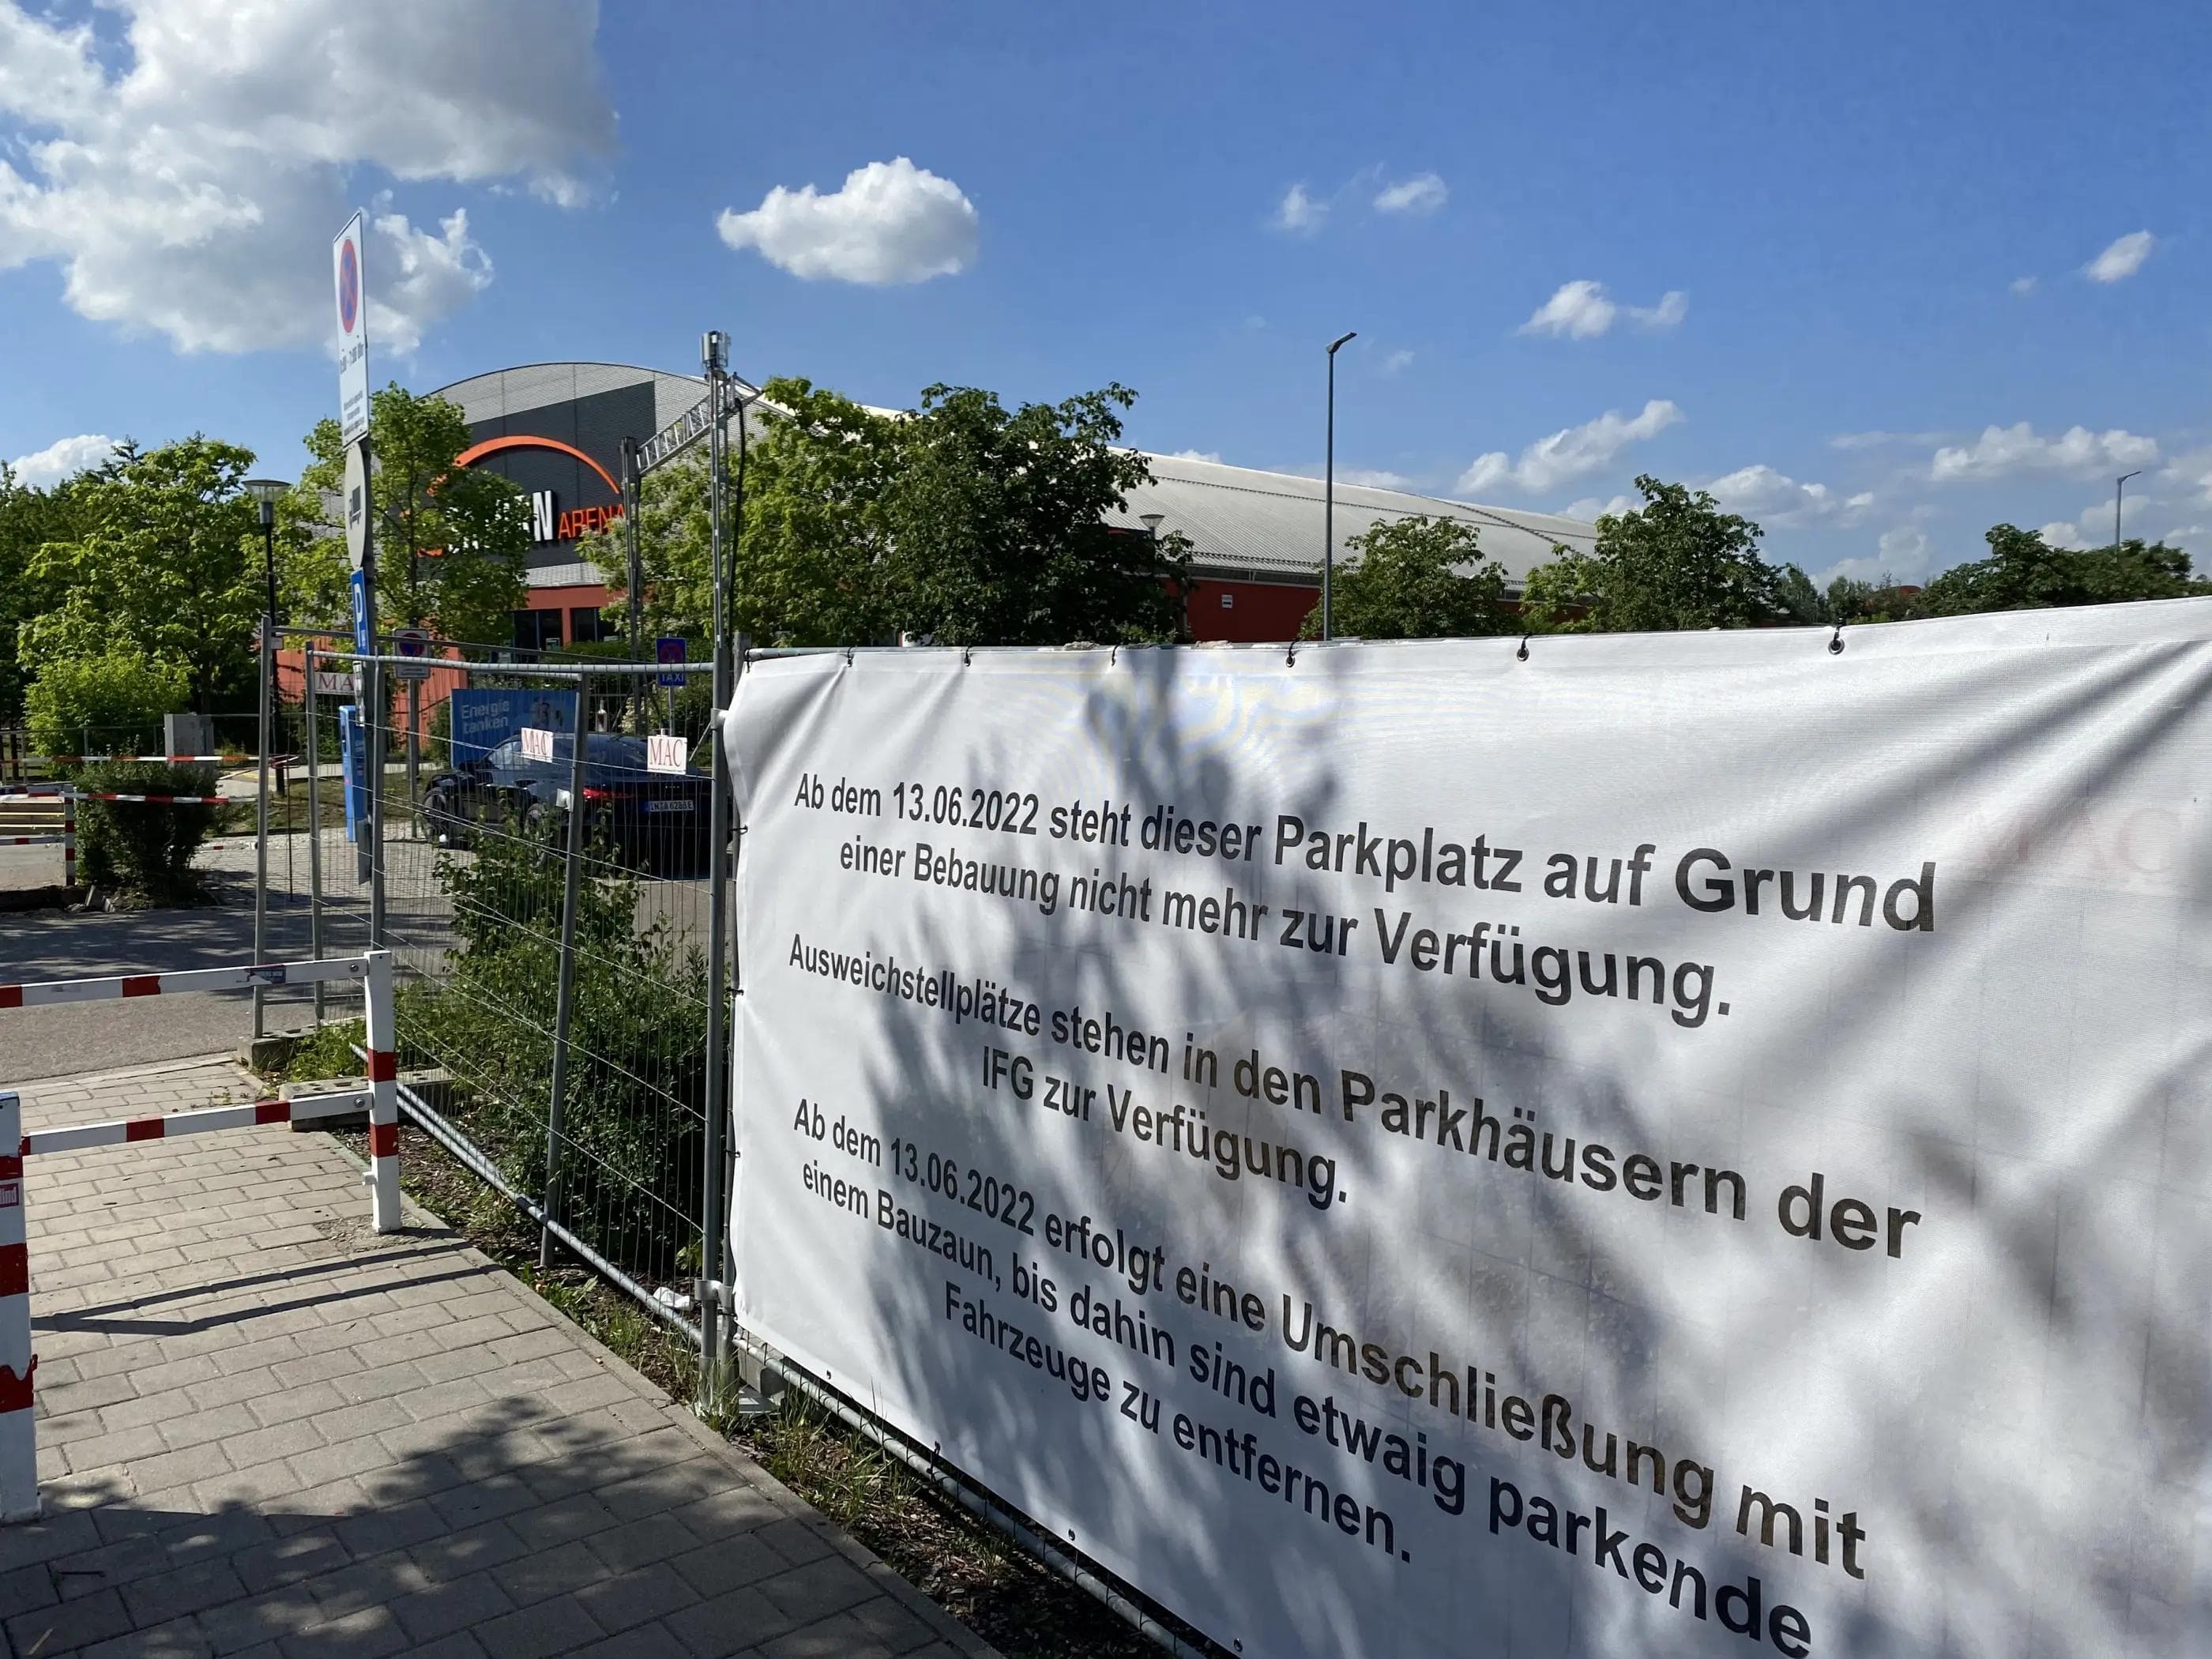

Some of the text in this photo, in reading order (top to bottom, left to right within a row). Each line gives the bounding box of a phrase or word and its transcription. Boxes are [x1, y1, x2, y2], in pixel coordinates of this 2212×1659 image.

[558, 503, 625, 539] ARENA
[318, 673, 355, 691] MA
[461, 699, 510, 720] Energie
[463, 716, 508, 734] tanken
[661, 672, 683, 683] TAXI
[524, 729, 549, 756] MAC
[649, 738, 683, 767] MAC
[795, 773, 1936, 931] Ab dem 13.06.2022 steht dieser Parkplatz auf Grund
[841, 835, 1729, 1028] einer Bebauung nicht mehr zur Verfügung.
[790, 934, 1921, 1258] Ausweichstellplätze stehen in den Parkhäusern der
[984, 1046, 1348, 1211] IFG zur Verfügung.
[794, 1099, 1865, 1579] Ab dem 13.06.2022 erfolgt eine Umschließung mit
[803, 1164, 1811, 1659] einem Bauzaun, bis dahin sind etwaig parkende
[945, 1280, 1411, 1563] Fahrzeuge zu entfernen.
